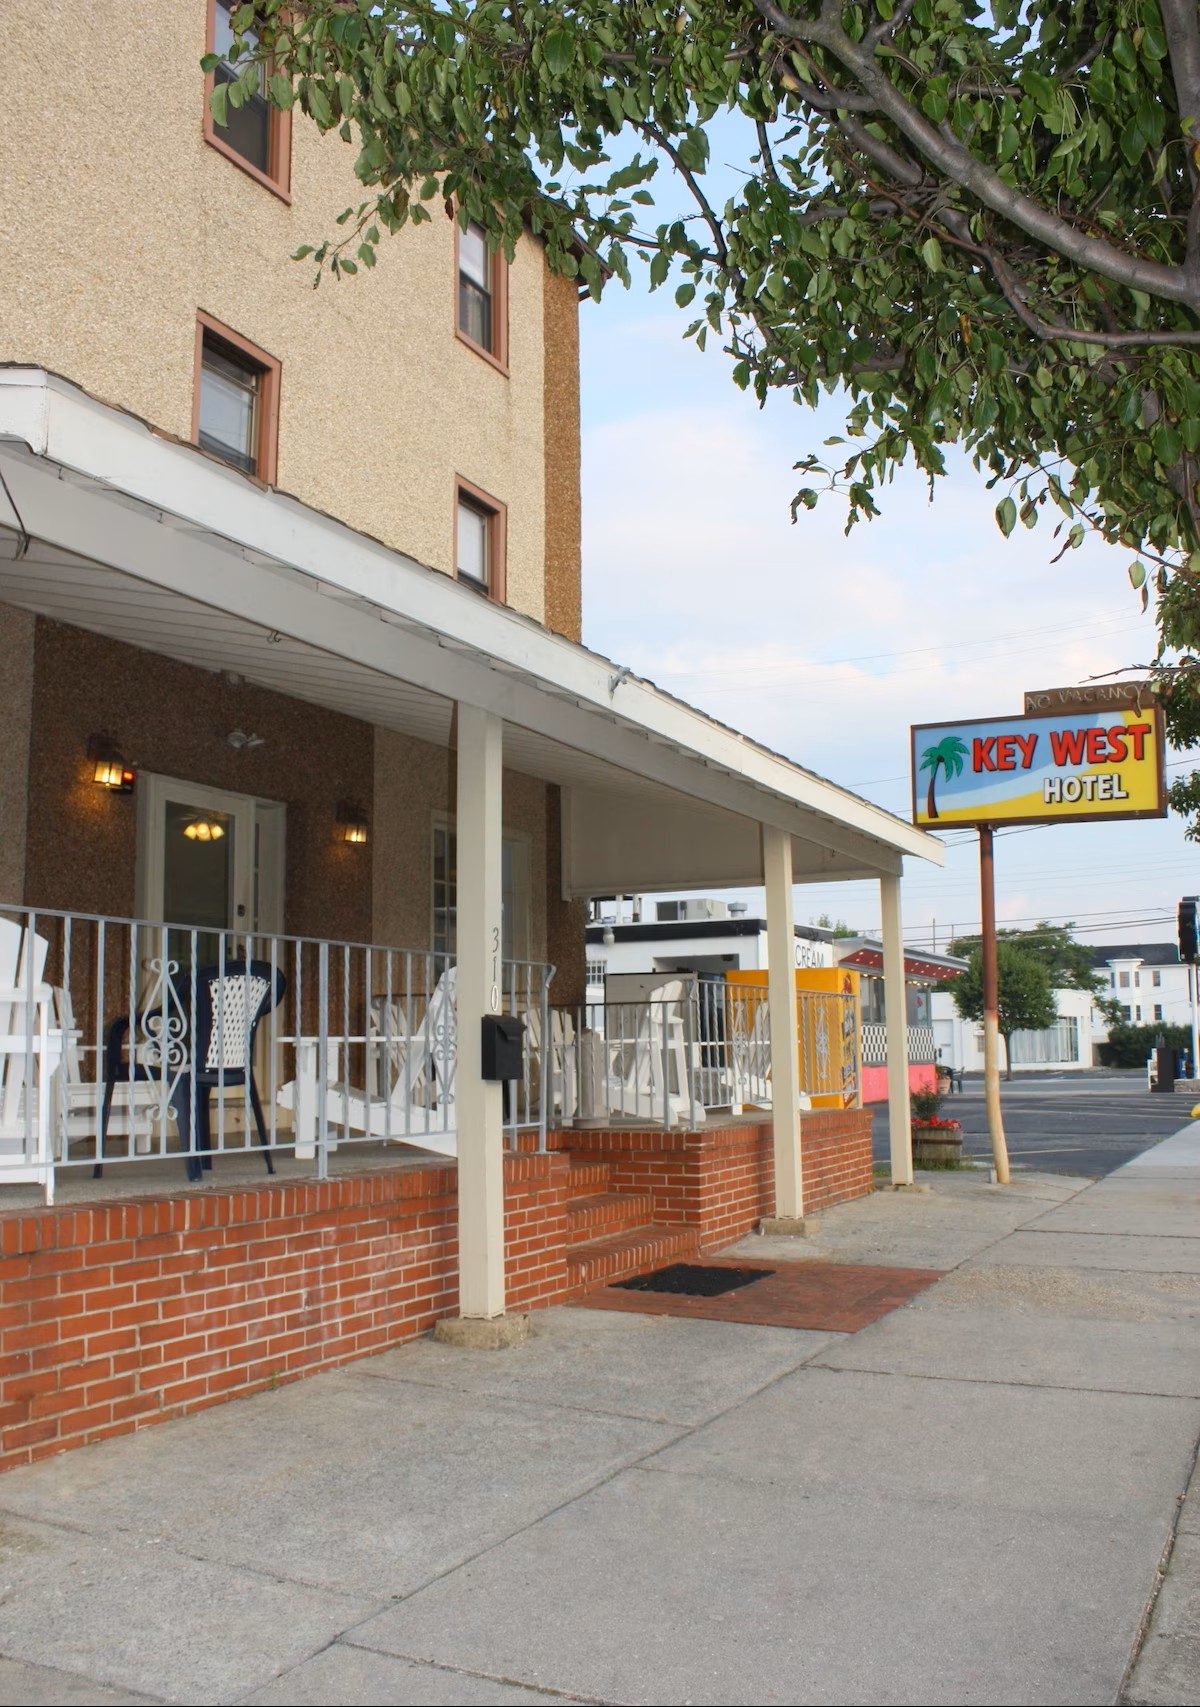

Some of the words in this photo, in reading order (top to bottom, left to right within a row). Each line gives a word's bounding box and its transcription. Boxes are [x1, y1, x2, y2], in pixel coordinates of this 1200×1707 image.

[973, 733, 1038, 773] KEY
[1050, 724, 1151, 766] WEST
[1043, 773, 1128, 803] HOTEL
[491, 927, 499, 1012] 310
[795, 944, 825, 969] CREAM
